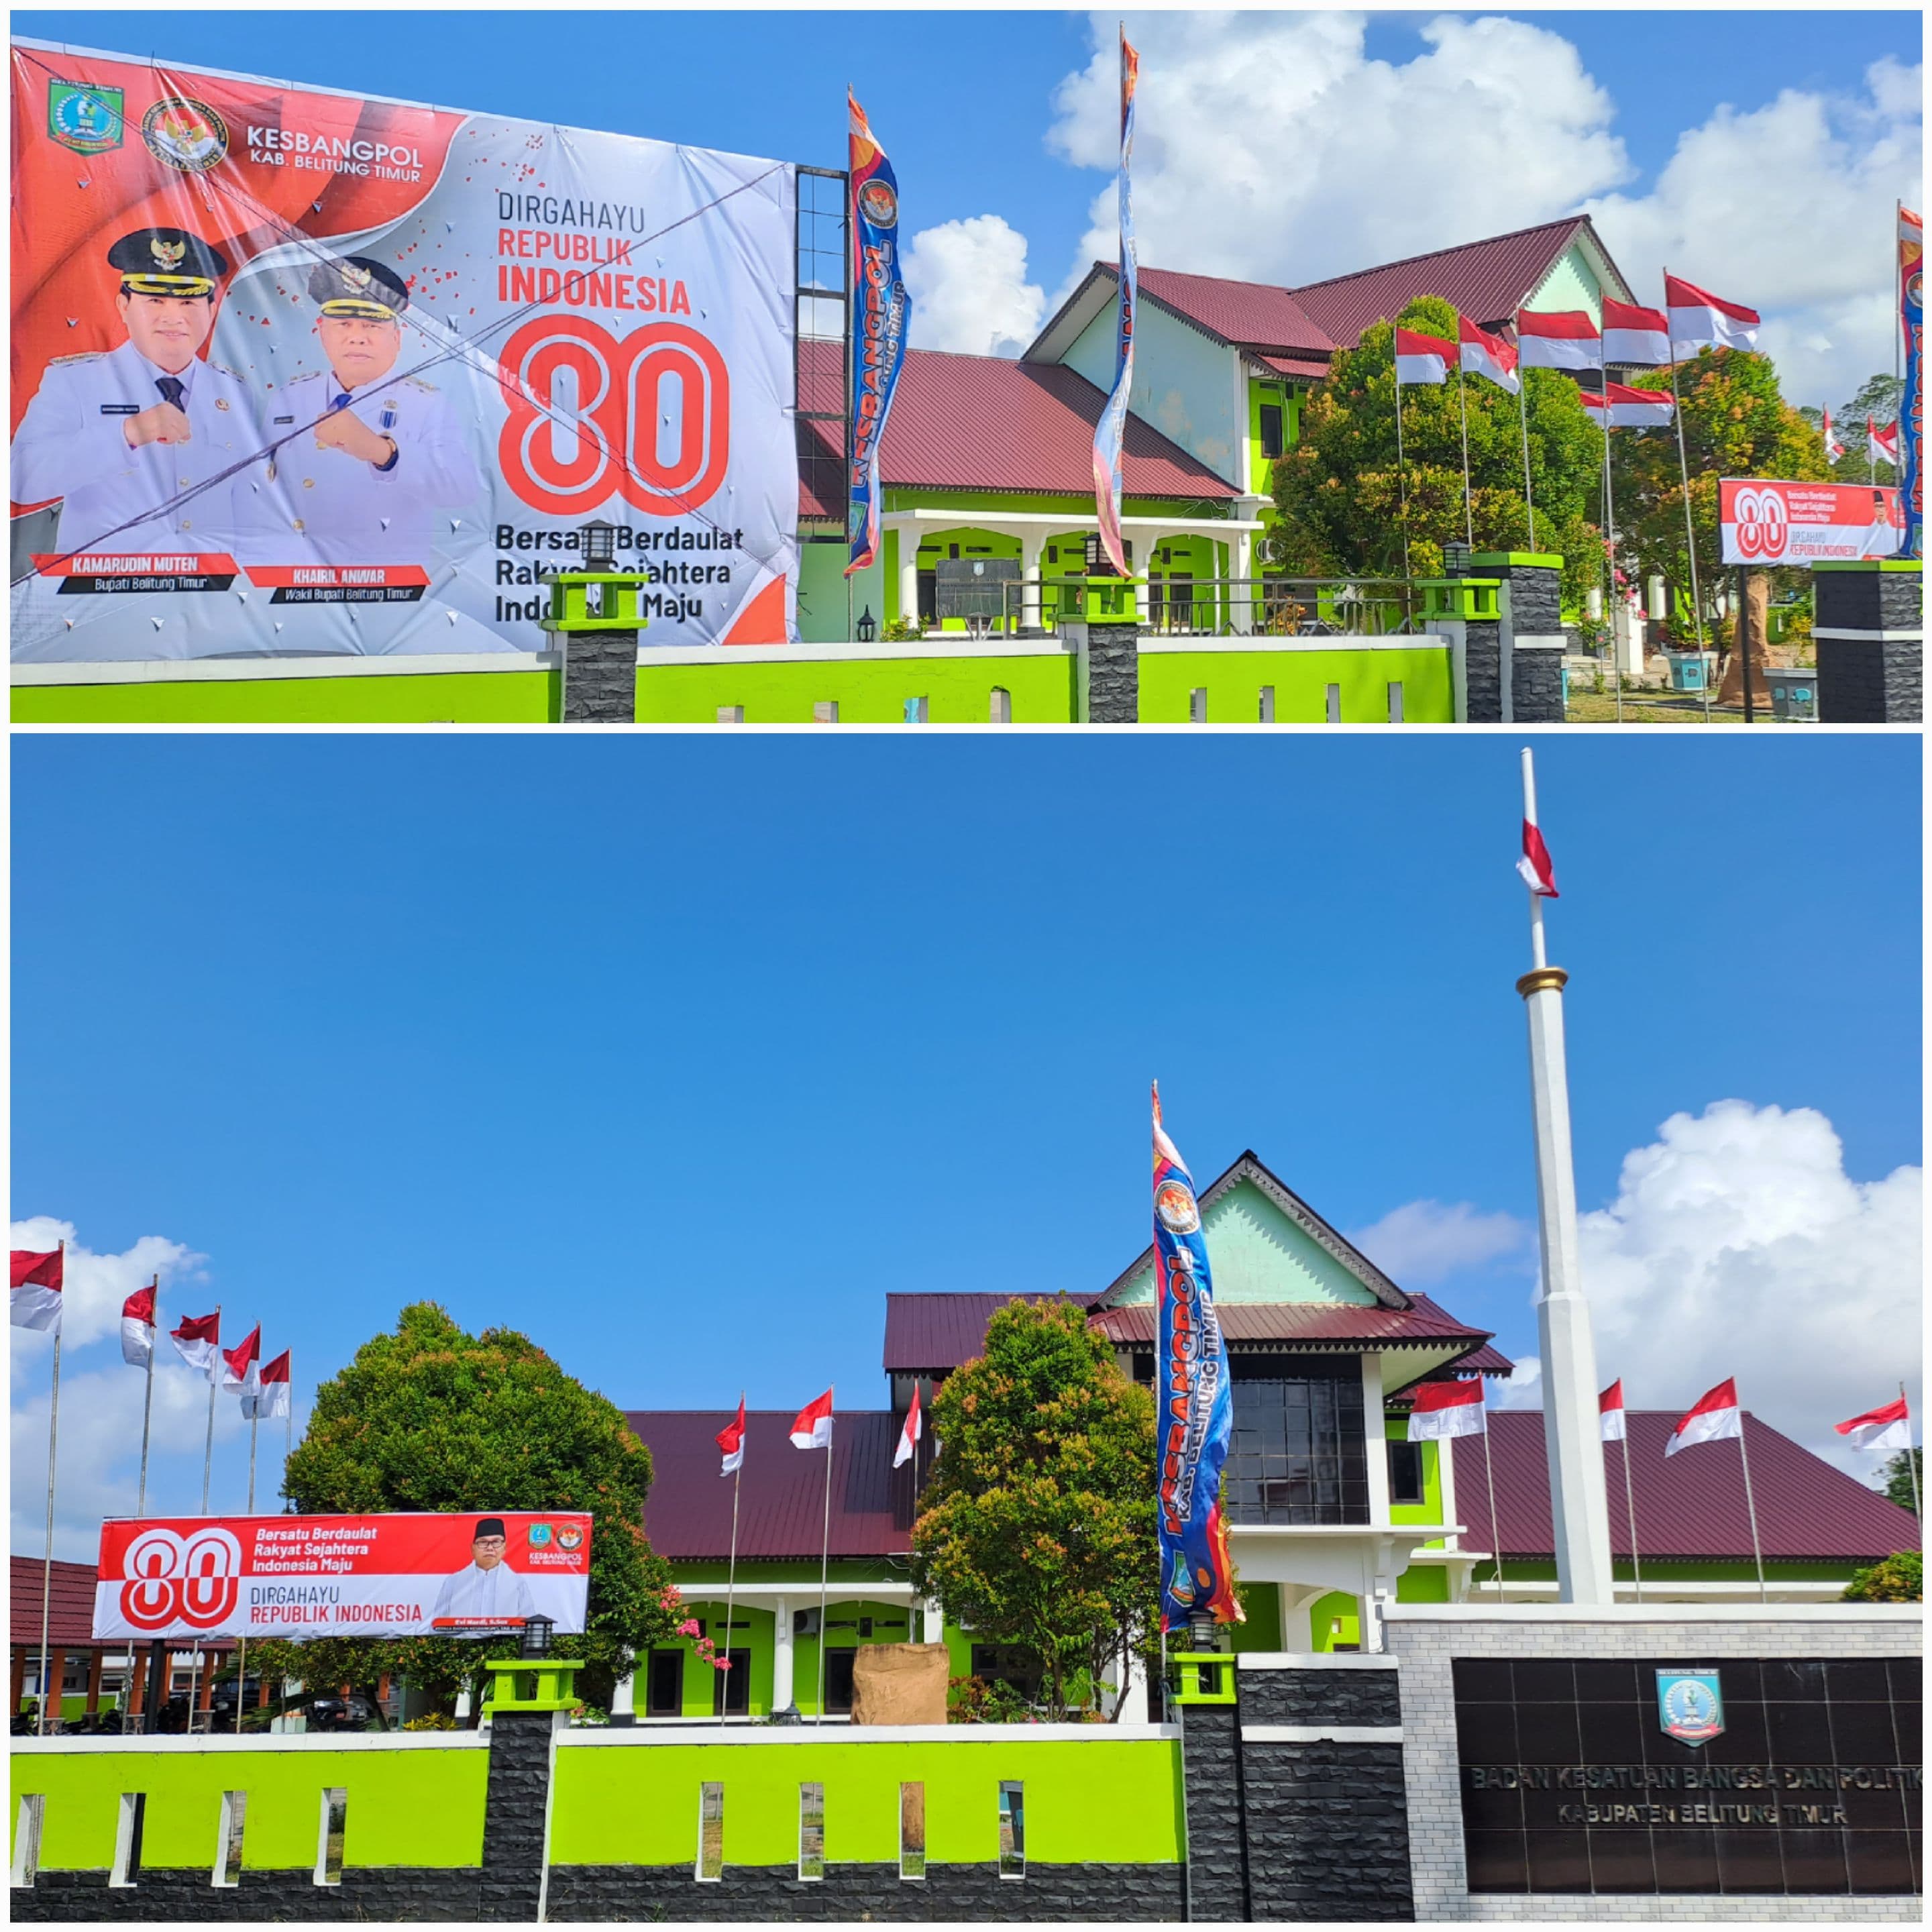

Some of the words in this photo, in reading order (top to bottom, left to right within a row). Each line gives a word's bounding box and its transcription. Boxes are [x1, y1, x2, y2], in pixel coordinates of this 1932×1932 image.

[247, 125, 423, 168] KESBANGPOL
[250, 149, 290, 167] KAB.
[294, 155, 371, 176] BELITUNG
[374, 165, 421, 182] TIMUR
[498, 193, 645, 233] DIRGAHAYU
[498, 228, 633, 266] REPUBLIK
[498, 265, 691, 315] INDONESIA
[887, 280, 905, 336] TIMUR
[851, 239, 893, 488] KESBANGPOL
[498, 313, 730, 517] 80
[496, 524, 580, 550] Bersa
[617, 525, 743, 550] Berdaulat
[1734, 487, 1788, 558] 80
[72, 557, 151, 573] KAMARUDIN
[154, 557, 198, 572] MUTEN
[293, 569, 337, 584] KHAIRIL
[341, 569, 385, 584] ANWAR
[95, 578, 129, 592] Bupati
[132, 578, 175, 591] Belitung
[178, 578, 207, 588] Timur
[285, 589, 312, 600] Wakil
[314, 589, 343, 602] Bupati
[346, 589, 384, 602] Belitung
[386, 588, 413, 599] Timur
[643, 593, 702, 624] Maju
[1161, 1246, 1199, 1536] KESBANGPOL
[1178, 1466, 1195, 1522] KAB.
[256, 1528, 309, 1541] Bersatu
[312, 1527, 377, 1540] Berdaulat
[254, 1543, 302, 1558] Rakyat
[304, 1542, 368, 1558] Sejahtera
[119, 1527, 242, 1630] 80
[252, 1558, 318, 1572] Indonesia
[321, 1558, 353, 1574] Maju
[251, 1586, 340, 1605] DIRGAHAYU
[251, 1605, 329, 1623] REPUBLIK
[335, 1604, 422, 1622] INDONESIA
[1471, 1768, 1550, 1789] BADAN
[1556, 1768, 1677, 1789] KESATUAN
[1682, 1768, 1780, 1789] BANGSA
[1784, 1768, 1835, 1789] DAN
[1556, 1804, 1677, 1823] KABUPATEN
[1681, 1804, 1779, 1823] BELITUNG
[1782, 1805, 1848, 1824] TIMUR
